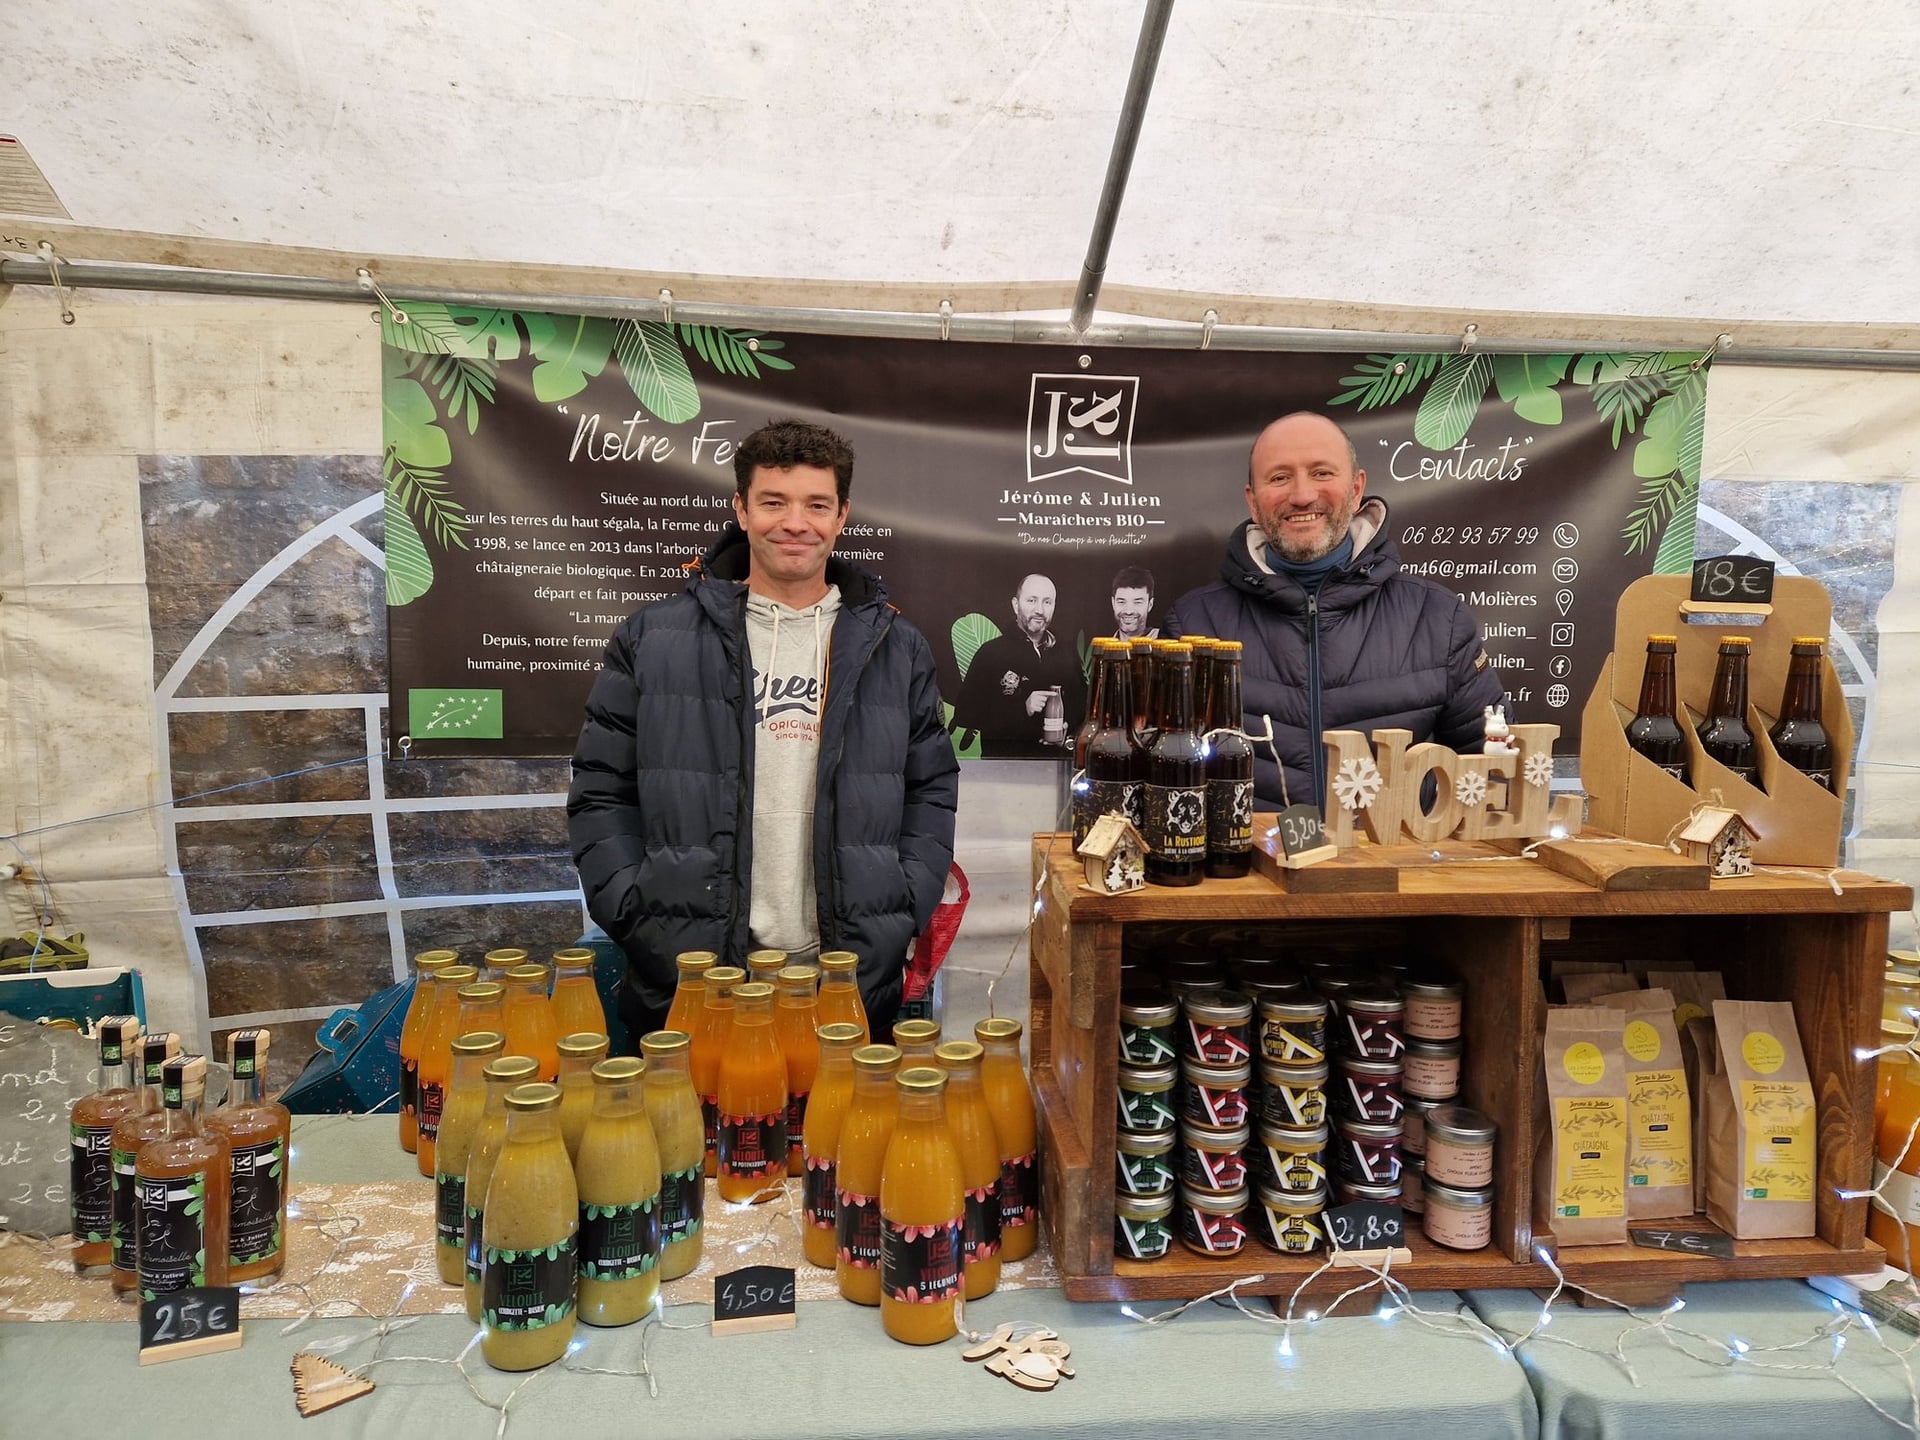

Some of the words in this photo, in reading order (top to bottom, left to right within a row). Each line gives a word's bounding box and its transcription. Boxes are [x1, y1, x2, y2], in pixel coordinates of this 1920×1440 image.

[600, 491, 638, 506] Située
[643, 496, 657, 507] au
[661, 493, 689, 507] nord
[692, 493, 708, 508] du
[711, 495, 728, 508] lot
[1000, 490, 1072, 505] Jérôme
[1080, 491, 1092, 506] &
[1100, 492, 1161, 506] Julien
[464, 513, 485, 525] sur
[489, 512, 507, 525] les
[511, 514, 548, 527] terres
[552, 514, 568, 527] du
[572, 514, 600, 528] haut
[602, 516, 644, 532] ségala,
[648, 518, 659, 531] la
[662, 518, 700, 532] Ferme
[703, 519, 719, 532] du
[1018, 512, 1111, 526] Maraîchers
[1116, 514, 1144, 527] BIO
[842, 524, 874, 537] créée
[877, 527, 892, 537] en
[1402, 526, 1427, 544] 06
[1431, 526, 1455, 544] 82
[1459, 526, 1482, 544] 93
[1488, 526, 1512, 544] 57
[1515, 526, 1539, 544] 99
[473, 536, 511, 551] 1998,
[514, 539, 528, 551] se
[533, 537, 565, 551] lance
[569, 541, 585, 552] en
[589, 541, 620, 554] 2013
[624, 540, 652, 554] dans
[1038, 536, 1050, 544] nos
[1052, 533, 1084, 550] Champs
[1086, 535, 1094, 544] à
[1095, 537, 1106, 545] vos
[831, 548, 884, 561] première
[475, 561, 562, 577] châtaigneraie
[566, 562, 636, 580] biologique.
[640, 565, 656, 578] En
[660, 567, 690, 579] 2018
[1400, 559, 1537, 578] en46@gmail.com
[1695, 561, 1770, 596] 18€
[534, 586, 574, 602] départ
[579, 589, 592, 600] et
[596, 588, 617, 600] fait
[621, 590, 667, 604] pousser
[1470, 591, 1537, 606] Molières
[482, 633, 531, 648] Depuis,
[535, 637, 568, 647] notre
[573, 635, 610, 648] ferme
[467, 657, 526, 672] humaine,
[529, 659, 590, 674] proximité
[1488, 653, 1535, 671] ulien_
[1504, 686, 1532, 702] n.fr
